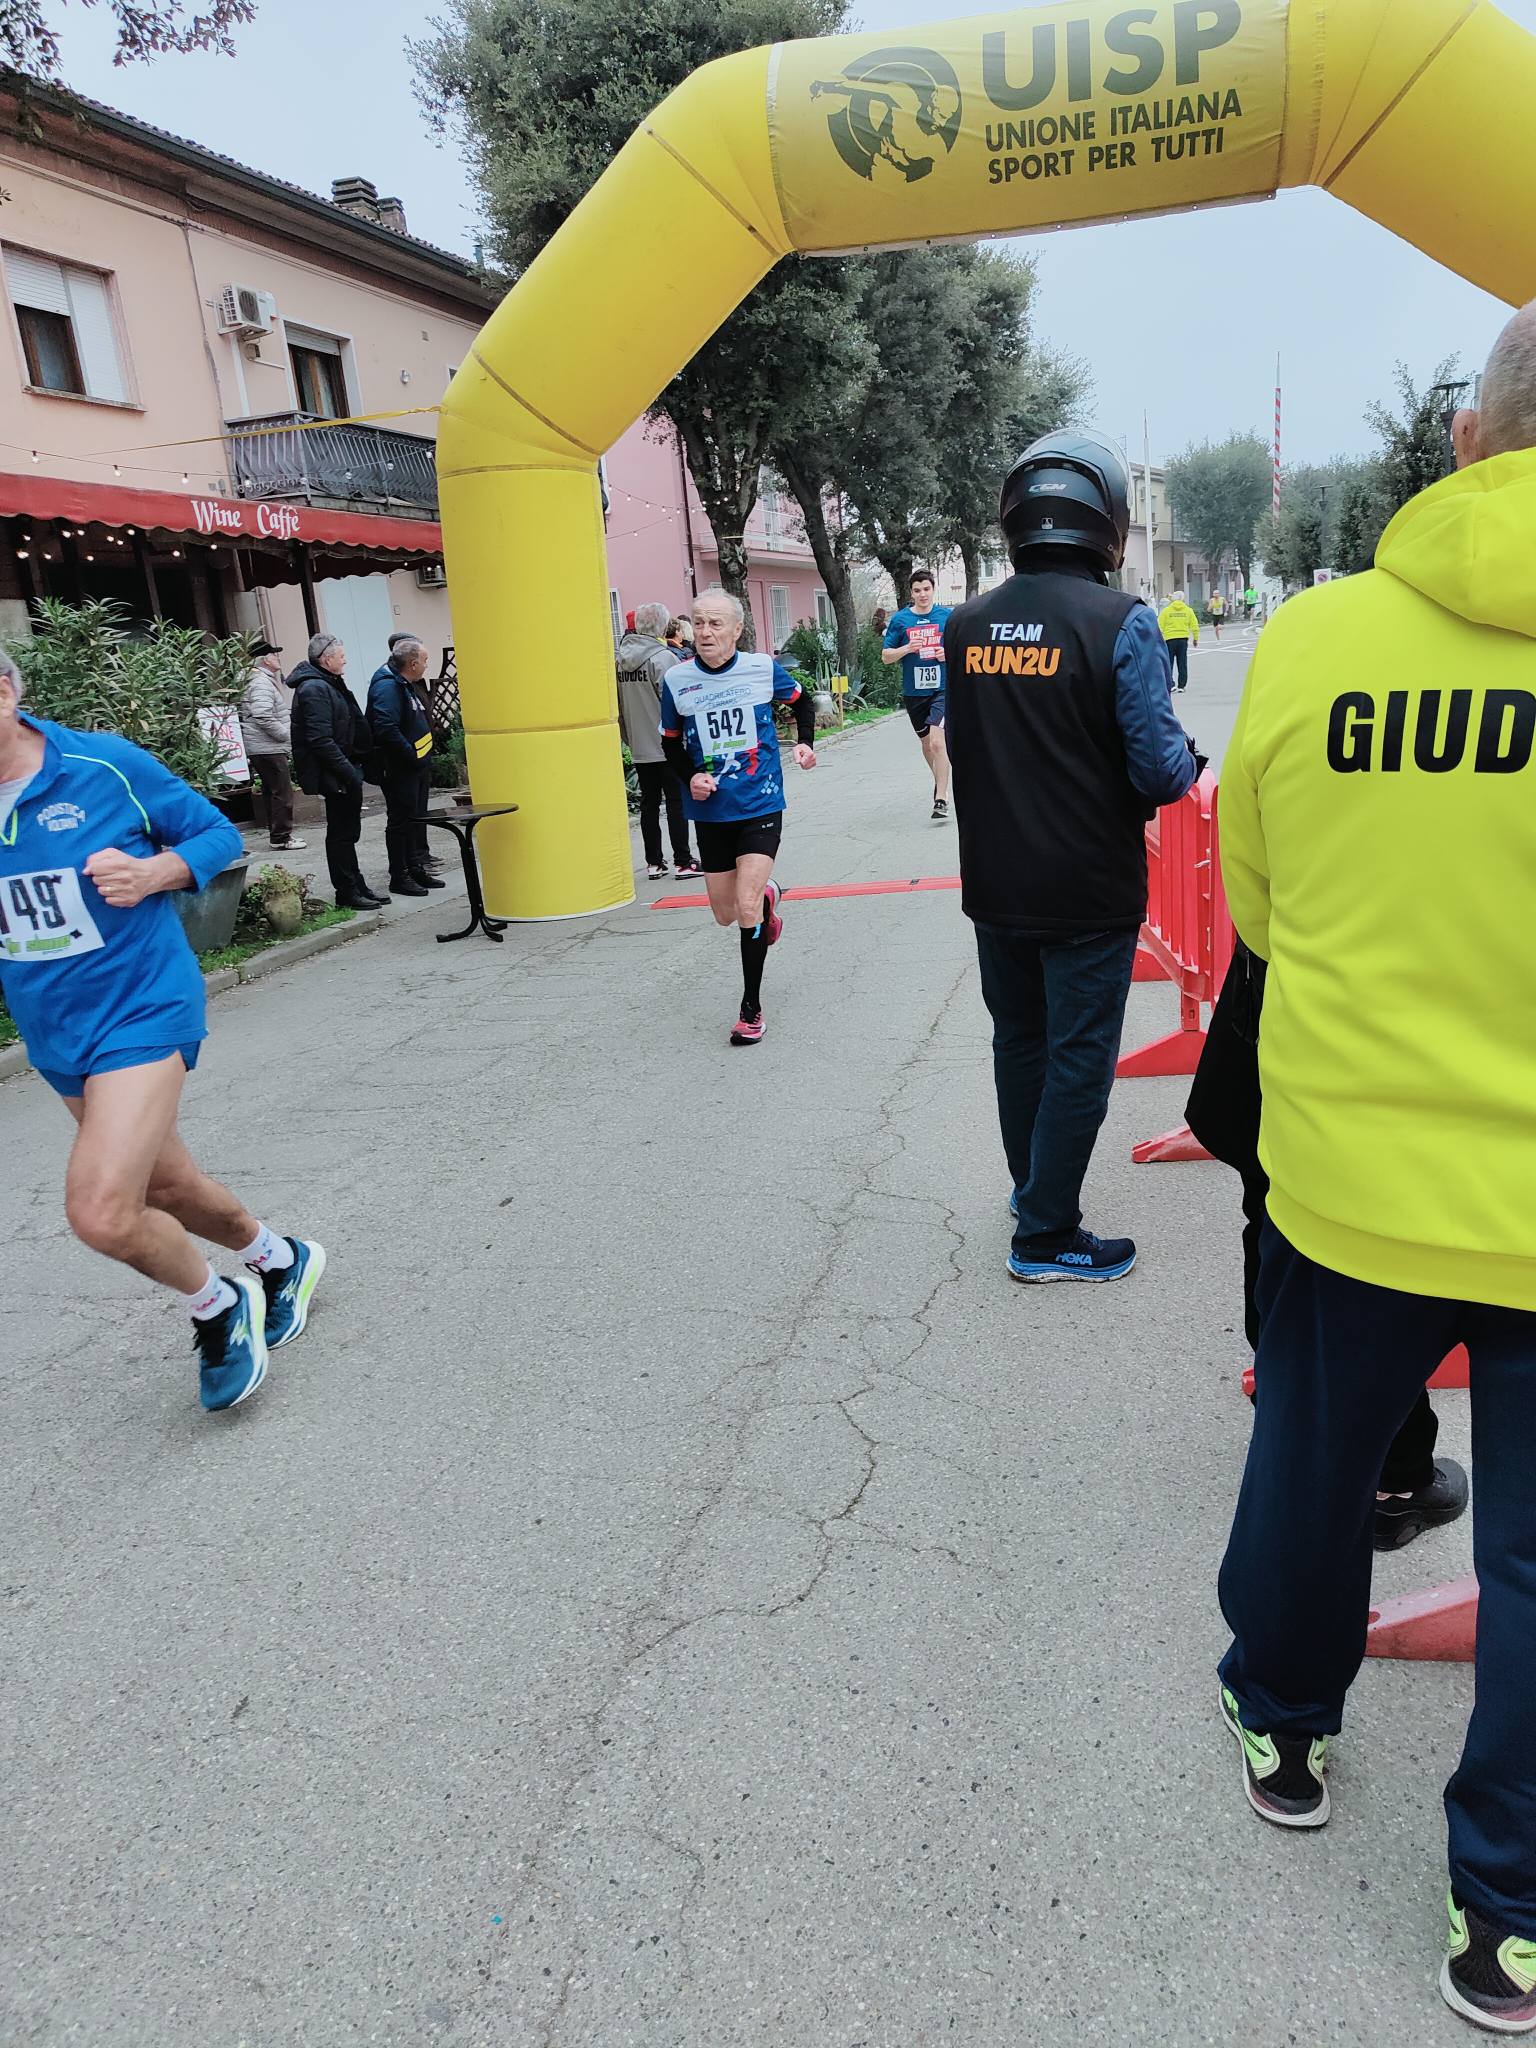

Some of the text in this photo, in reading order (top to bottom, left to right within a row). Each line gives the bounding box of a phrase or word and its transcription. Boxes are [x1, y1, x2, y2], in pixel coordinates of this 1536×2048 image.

[982, 0, 1242, 111] UISP
[985, 88, 1242, 152] UNIONE ITALIANA
[988, 126, 1224, 184] SPORT PER TUTTI
[190, 500, 243, 532] Wine
[990, 623, 1044, 642] TEAM
[919, 667, 937, 682] 733
[965, 645, 1061, 677] RUN2U
[706, 707, 747, 740] 542
[1326, 688, 1536, 774] GIUD
[1055, 1251, 1093, 1266] HOKA
